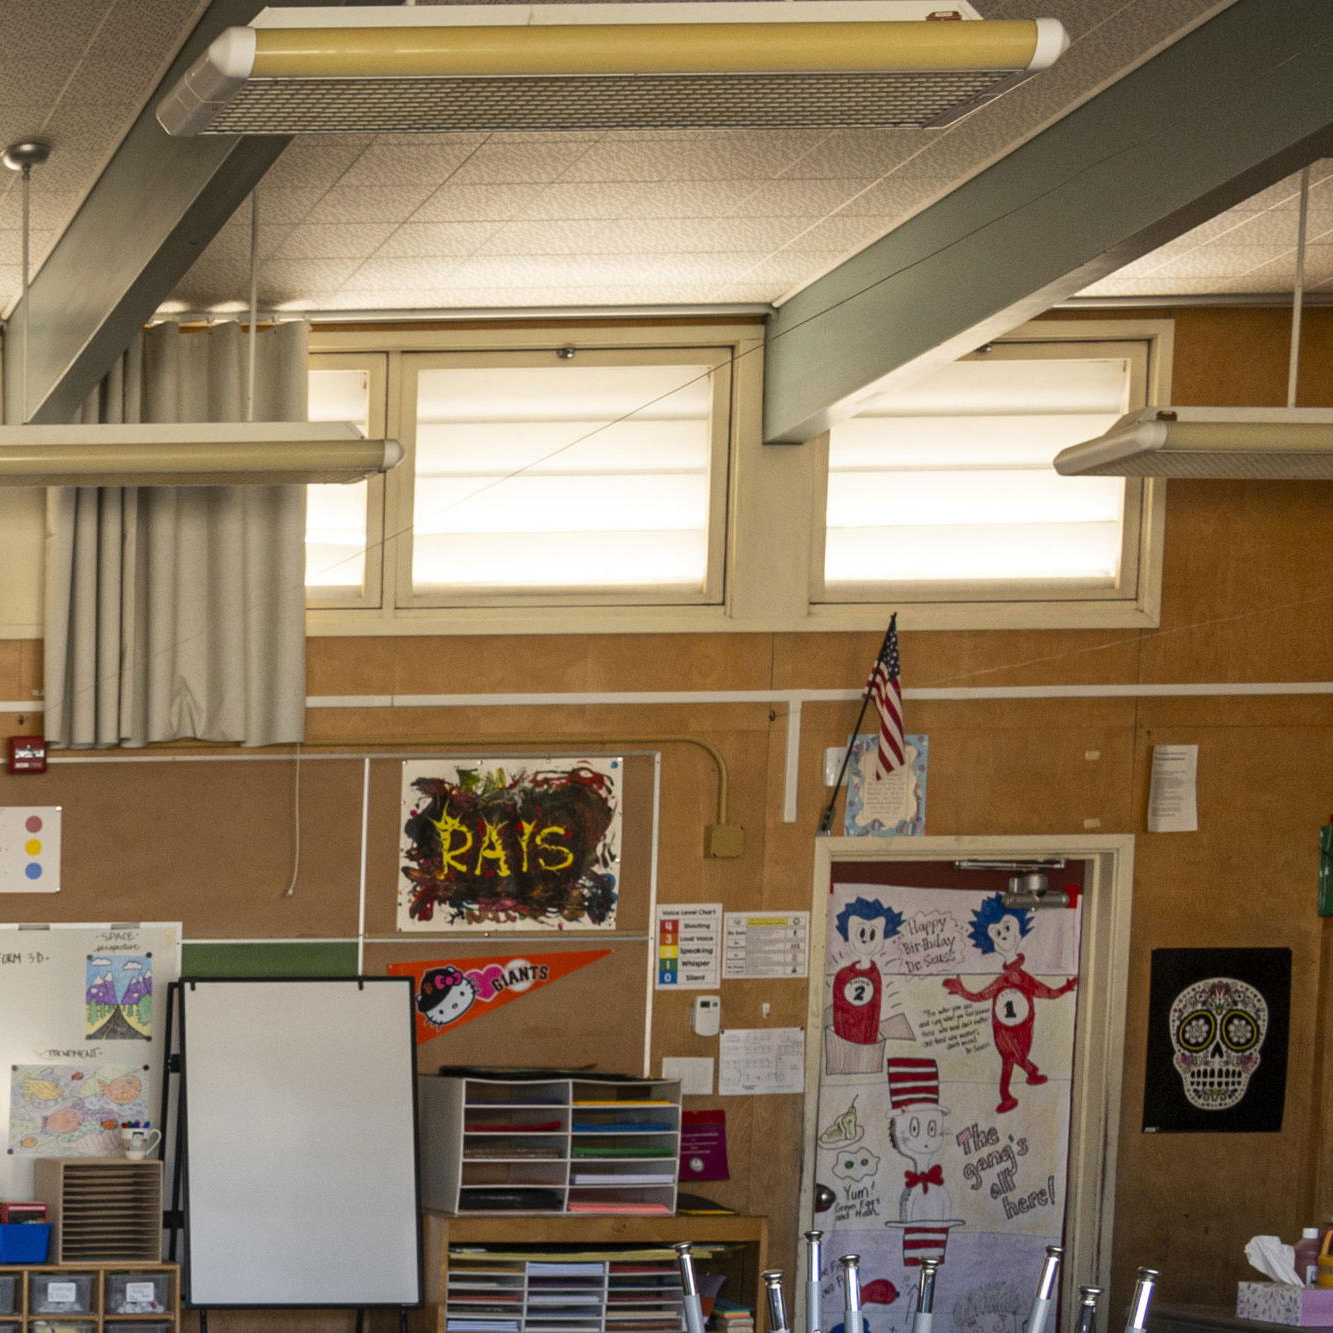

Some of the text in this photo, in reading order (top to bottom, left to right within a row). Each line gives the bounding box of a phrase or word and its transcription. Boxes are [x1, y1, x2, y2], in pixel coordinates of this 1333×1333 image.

[428, 800, 575, 879] RAYS
[665, 921, 673, 930] 4
[907, 916, 947, 937] Happy
[100, 931, 136, 942] SPACE
[665, 934, 672, 944] 3
[680, 947, 713, 955] Speaking
[902, 934, 957, 957] Birthday
[681, 959, 710, 968] Whisper
[924, 951, 958, 967] Seuss
[491, 965, 549, 993] GIANTS
[664, 972, 672, 982] 0
[853, 985, 866, 1001] 2
[1003, 1001, 1017, 1019] 1
[956, 1122, 1000, 1155] The
[963, 1134, 1029, 1191] gang's
[843, 1180, 875, 1201] Yum!
[989, 1166, 1016, 1200] all
[835, 1198, 880, 1213] Green Eggs
[1002, 1175, 1055, 1220] here!
[835, 1212, 850, 1221] and
